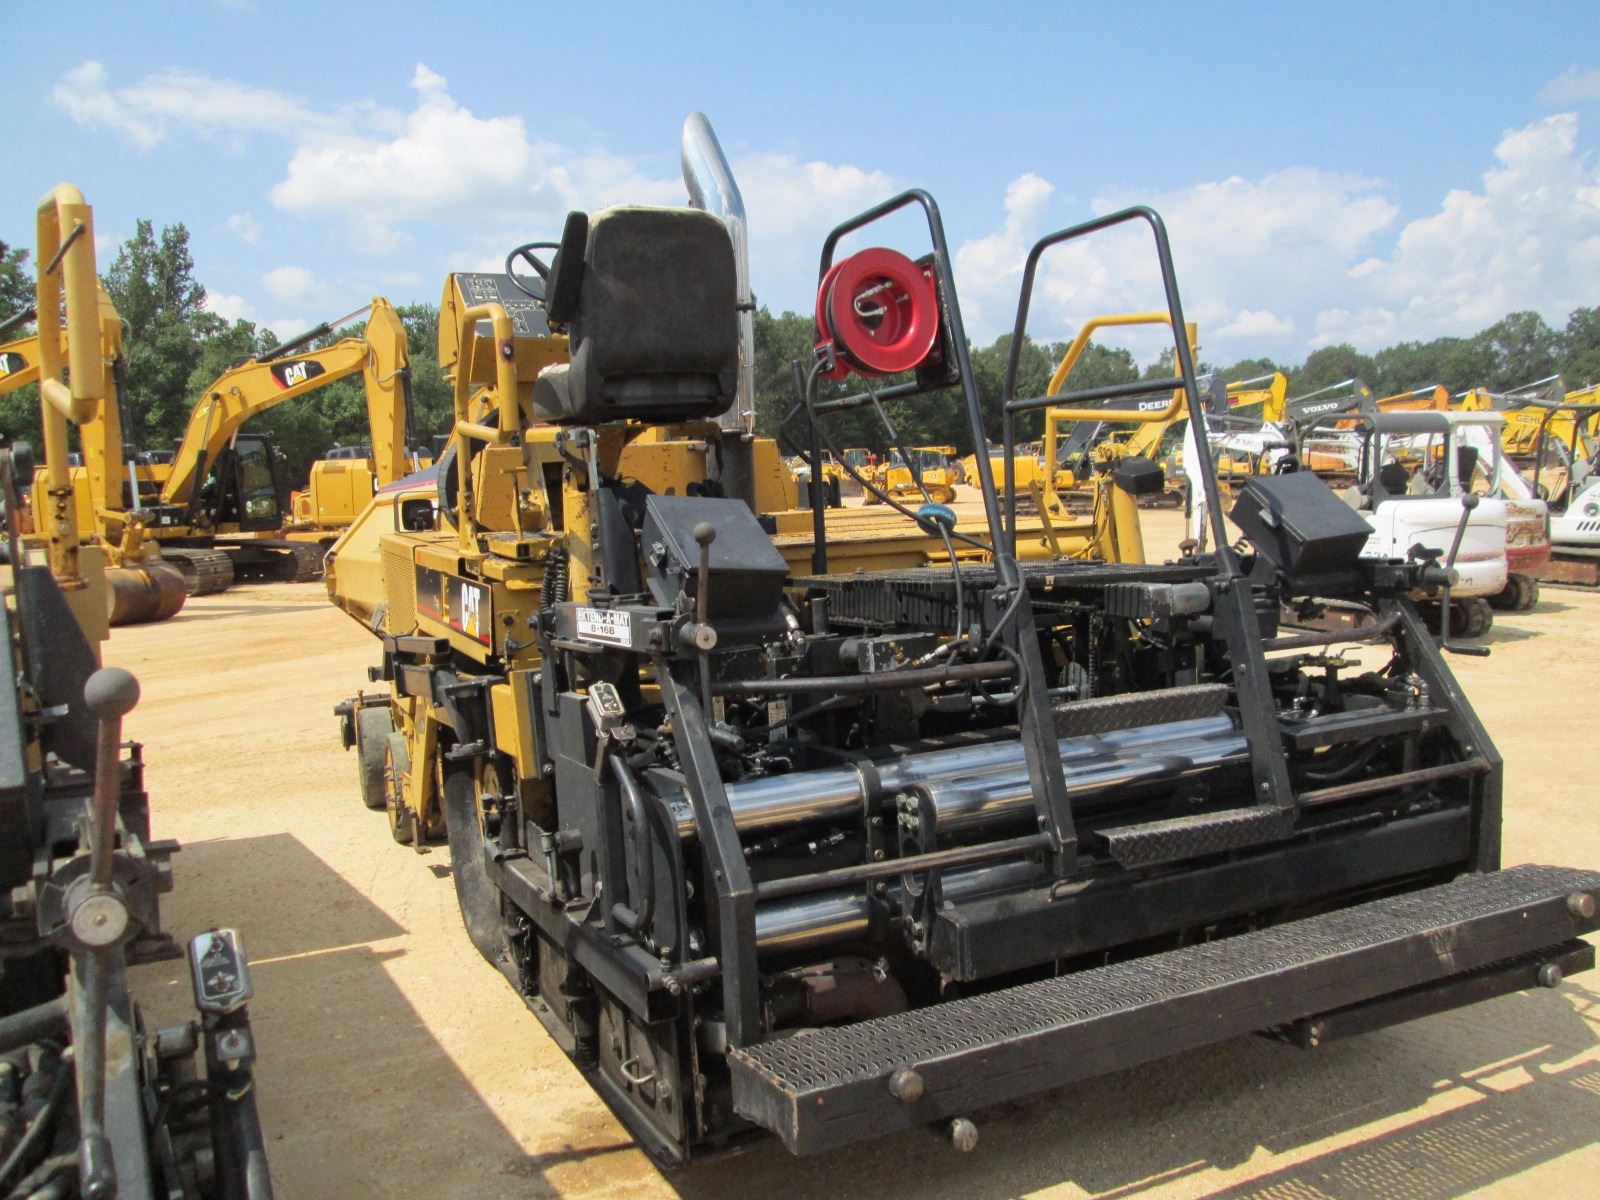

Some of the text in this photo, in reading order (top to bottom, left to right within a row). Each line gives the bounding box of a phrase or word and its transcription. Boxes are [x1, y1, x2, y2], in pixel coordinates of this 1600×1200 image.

[285, 361, 307, 386] CAT
[1302, 402, 1338, 413] VOLVO
[461, 583, 480, 638] CAT
